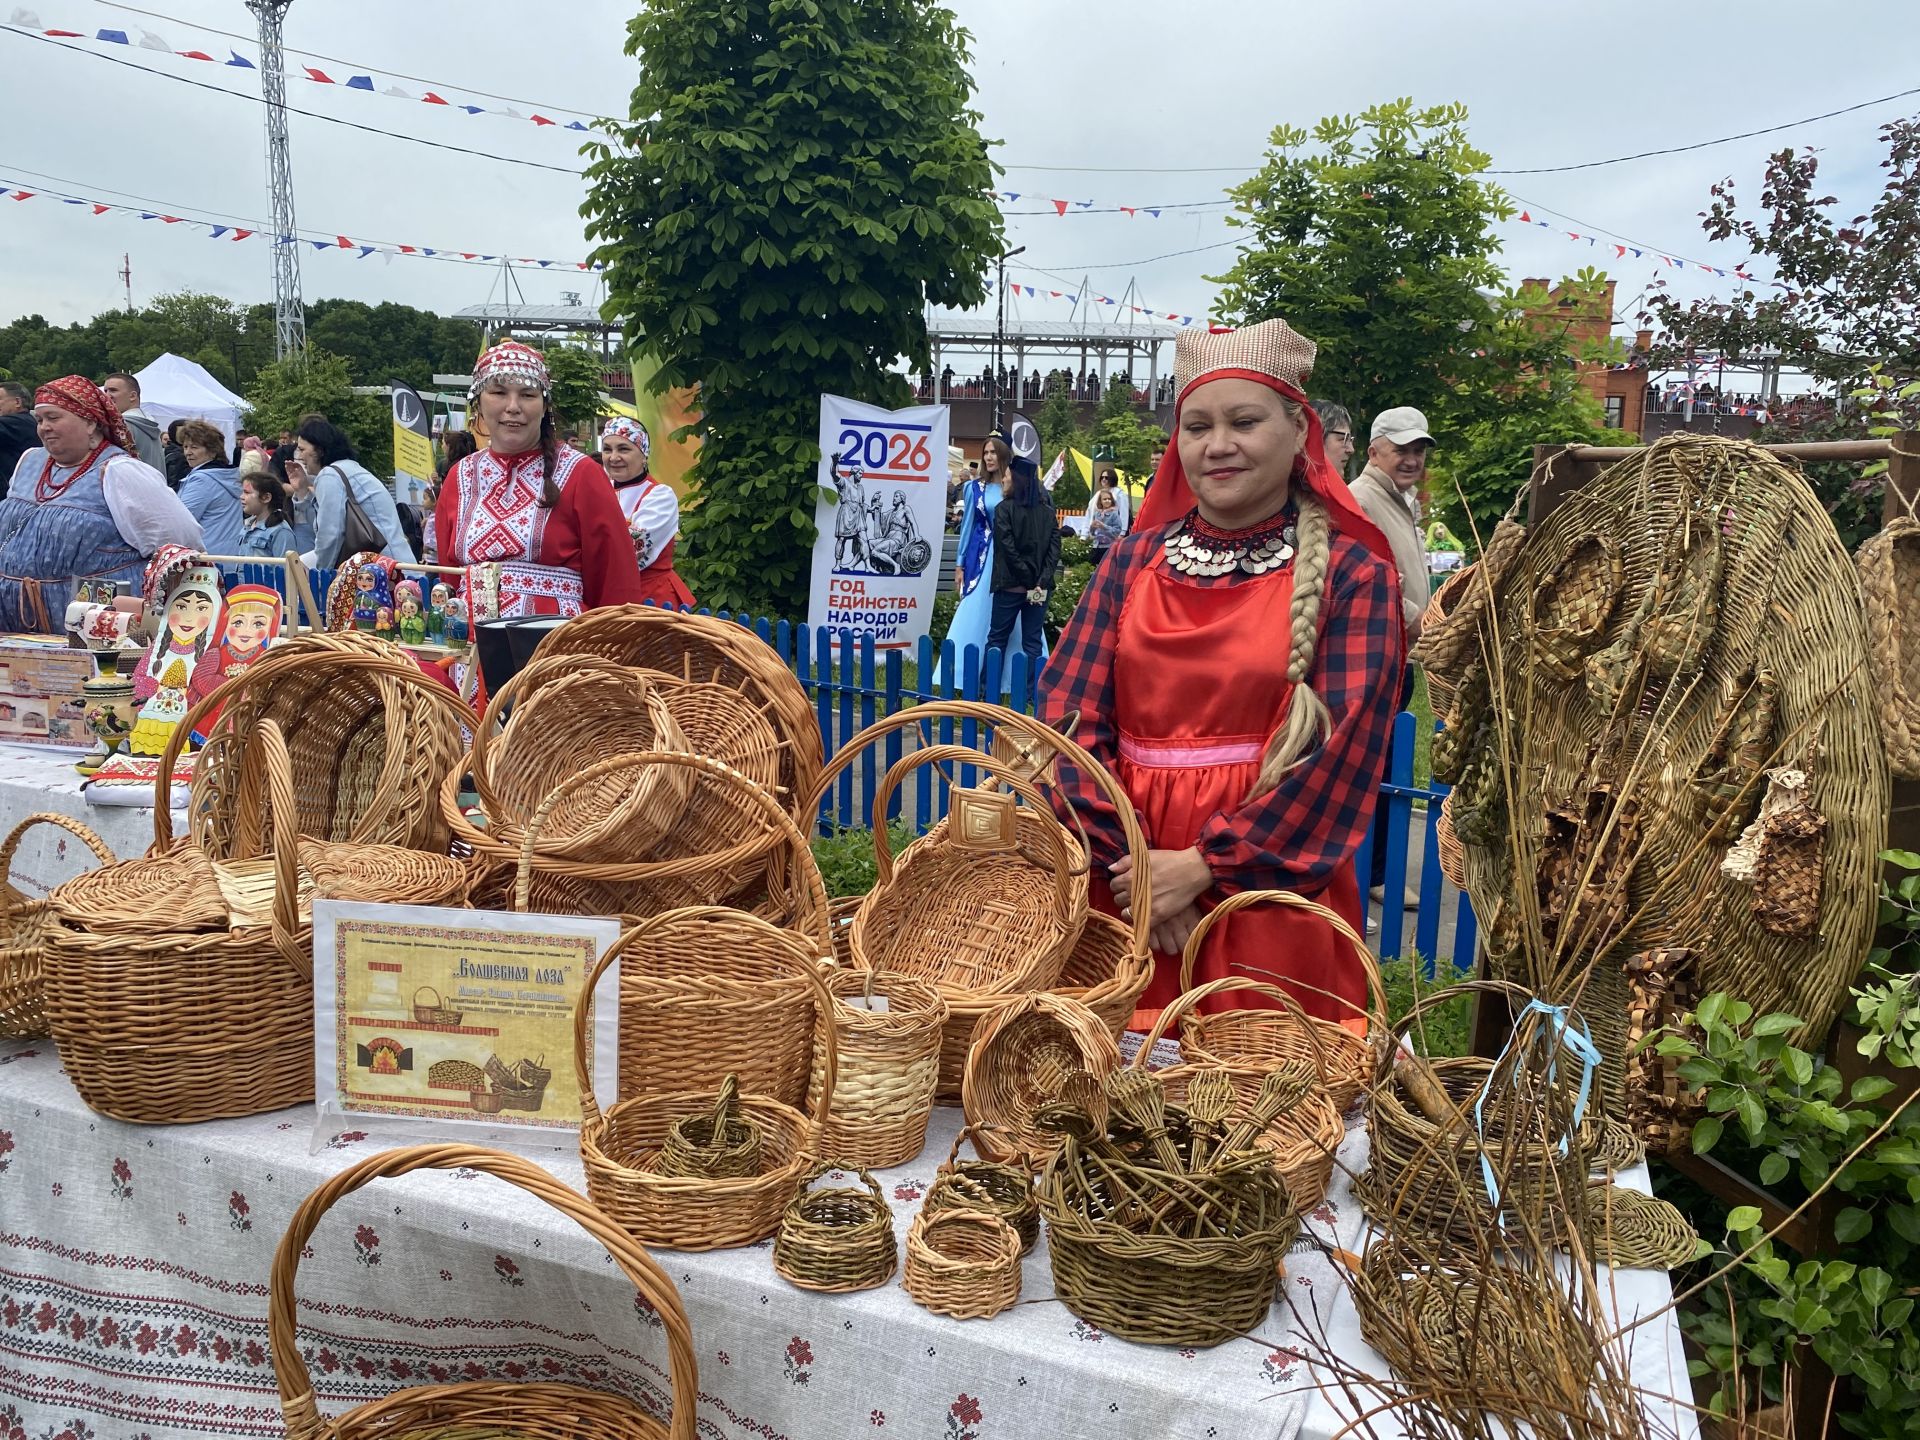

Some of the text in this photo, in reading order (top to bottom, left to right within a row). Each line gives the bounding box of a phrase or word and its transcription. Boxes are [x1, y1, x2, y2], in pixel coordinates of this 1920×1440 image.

[839, 429, 931, 471] 2026
[830, 579, 865, 595] ГОД
[829, 595, 917, 610] ЕДИНСТВА
[828, 611, 908, 626] НАРОДОВ
